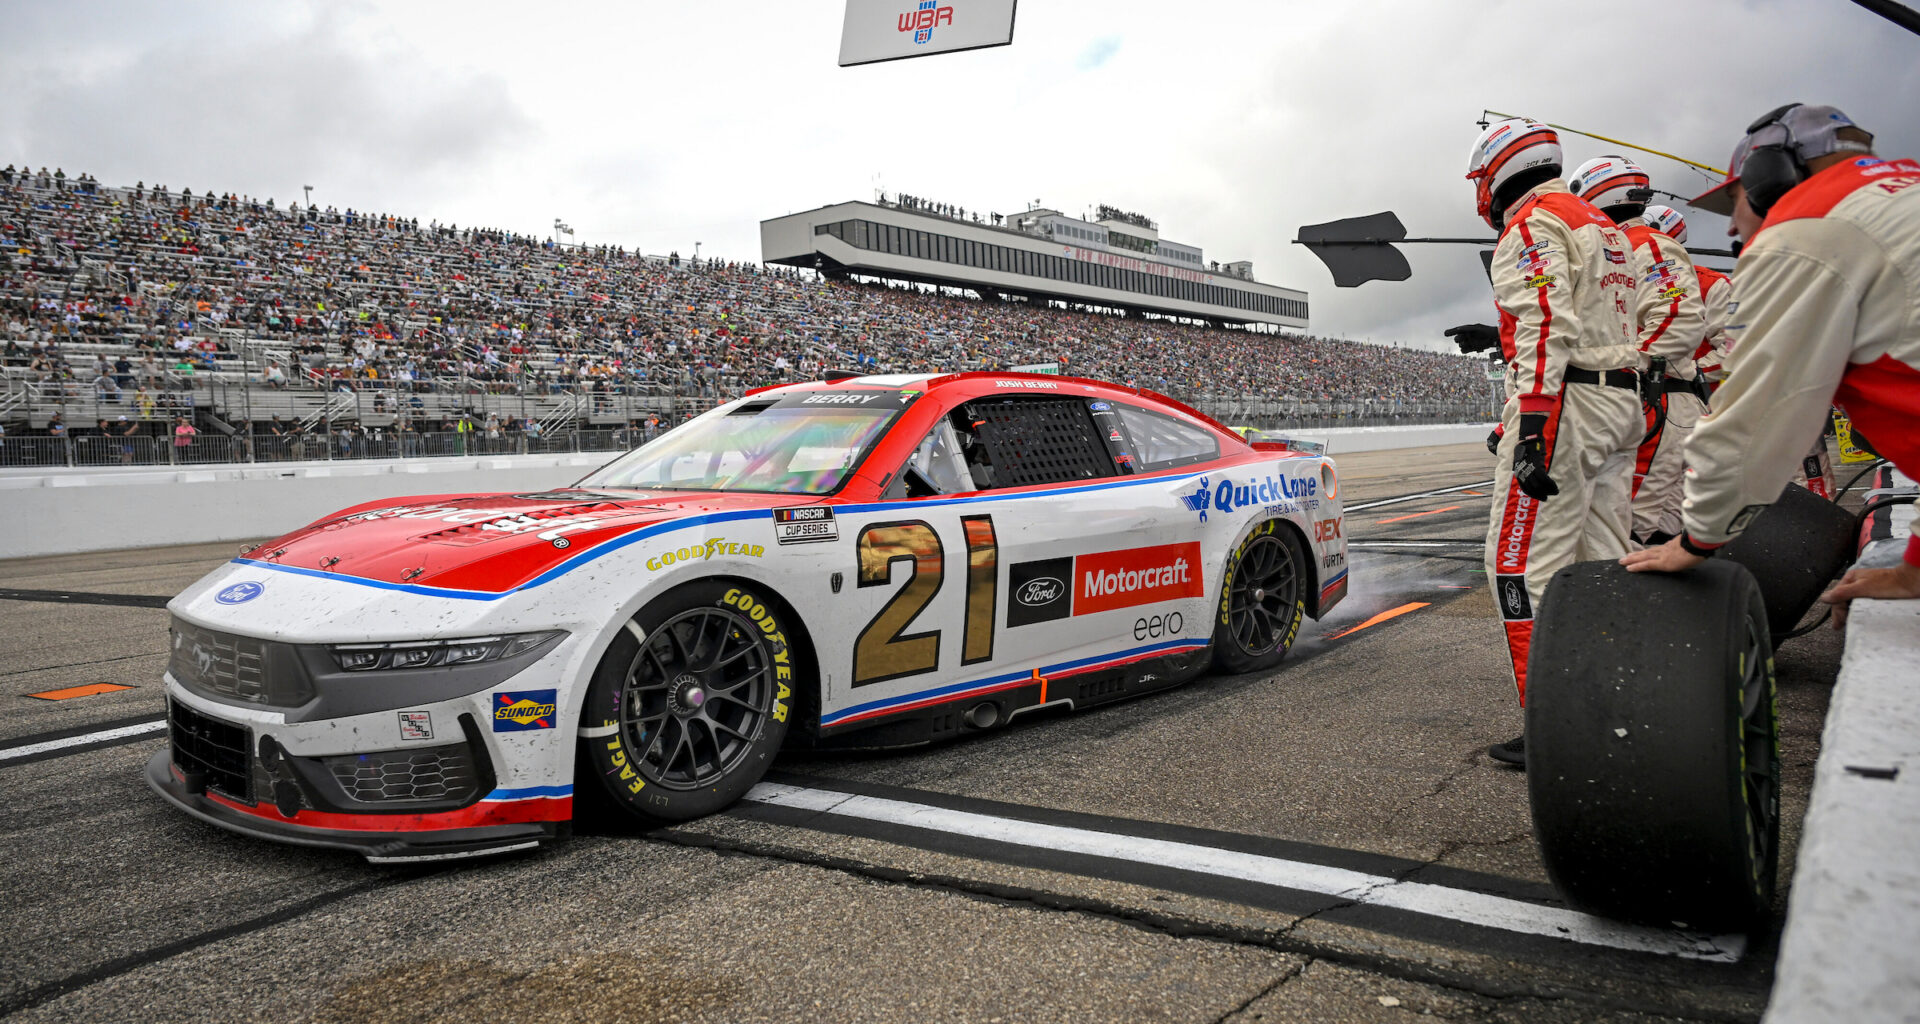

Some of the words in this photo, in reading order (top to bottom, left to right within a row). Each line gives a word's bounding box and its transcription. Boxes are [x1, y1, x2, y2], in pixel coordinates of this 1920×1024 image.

[898, 6, 953, 32] WBR
[1075, 248, 1093, 262] NEW
[1098, 254, 1141, 271] HAMPSHIRE
[1146, 262, 1169, 276] MOTOR
[1173, 267, 1205, 283] SPEEDWAY
[801, 395, 880, 404] BERRY
[1214, 476, 1283, 513] Quick
[1280, 474, 1317, 499] Lane
[794, 508, 825, 520] NASCAR
[1264, 505, 1284, 517] TIRE
[1284, 503, 1291, 514] &
[786, 525, 801, 535] CUP
[802, 523, 828, 534] SERIES
[1314, 517, 1342, 542] DEX
[1503, 486, 1532, 567] Motorcraf
[646, 538, 765, 571] GOODYEAR
[1025, 581, 1056, 603] Ford
[1084, 557, 1189, 598] Motorcraft
[851, 514, 999, 689] 21
[1133, 611, 1183, 641] eero
[1283, 600, 1304, 649] EAGLE
[723, 588, 791, 723] GOODYEAR
[497, 704, 553, 719] SUNOCO
[603, 719, 646, 794] EAGLE
